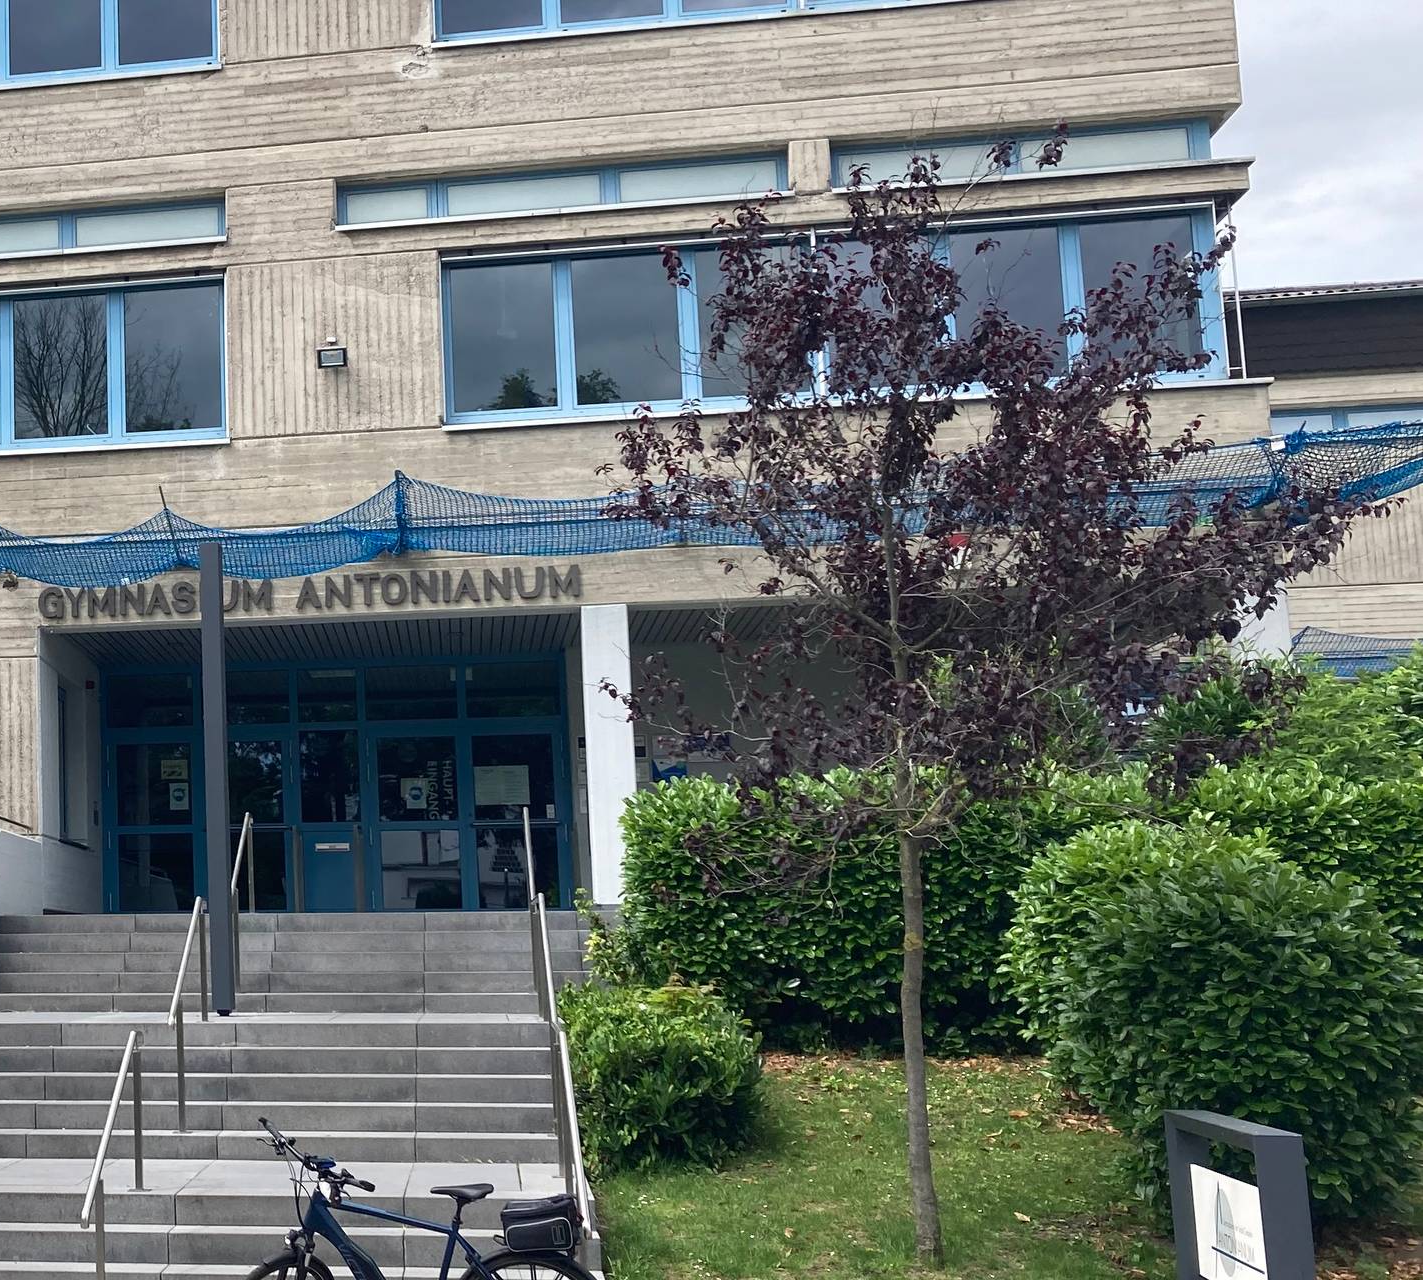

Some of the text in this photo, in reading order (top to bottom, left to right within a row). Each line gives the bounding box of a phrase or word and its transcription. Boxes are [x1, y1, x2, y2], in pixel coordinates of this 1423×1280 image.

[37, 564, 581, 620] GYMNASUM ANTONIANUM
[427, 760, 440, 820] EINGANG
